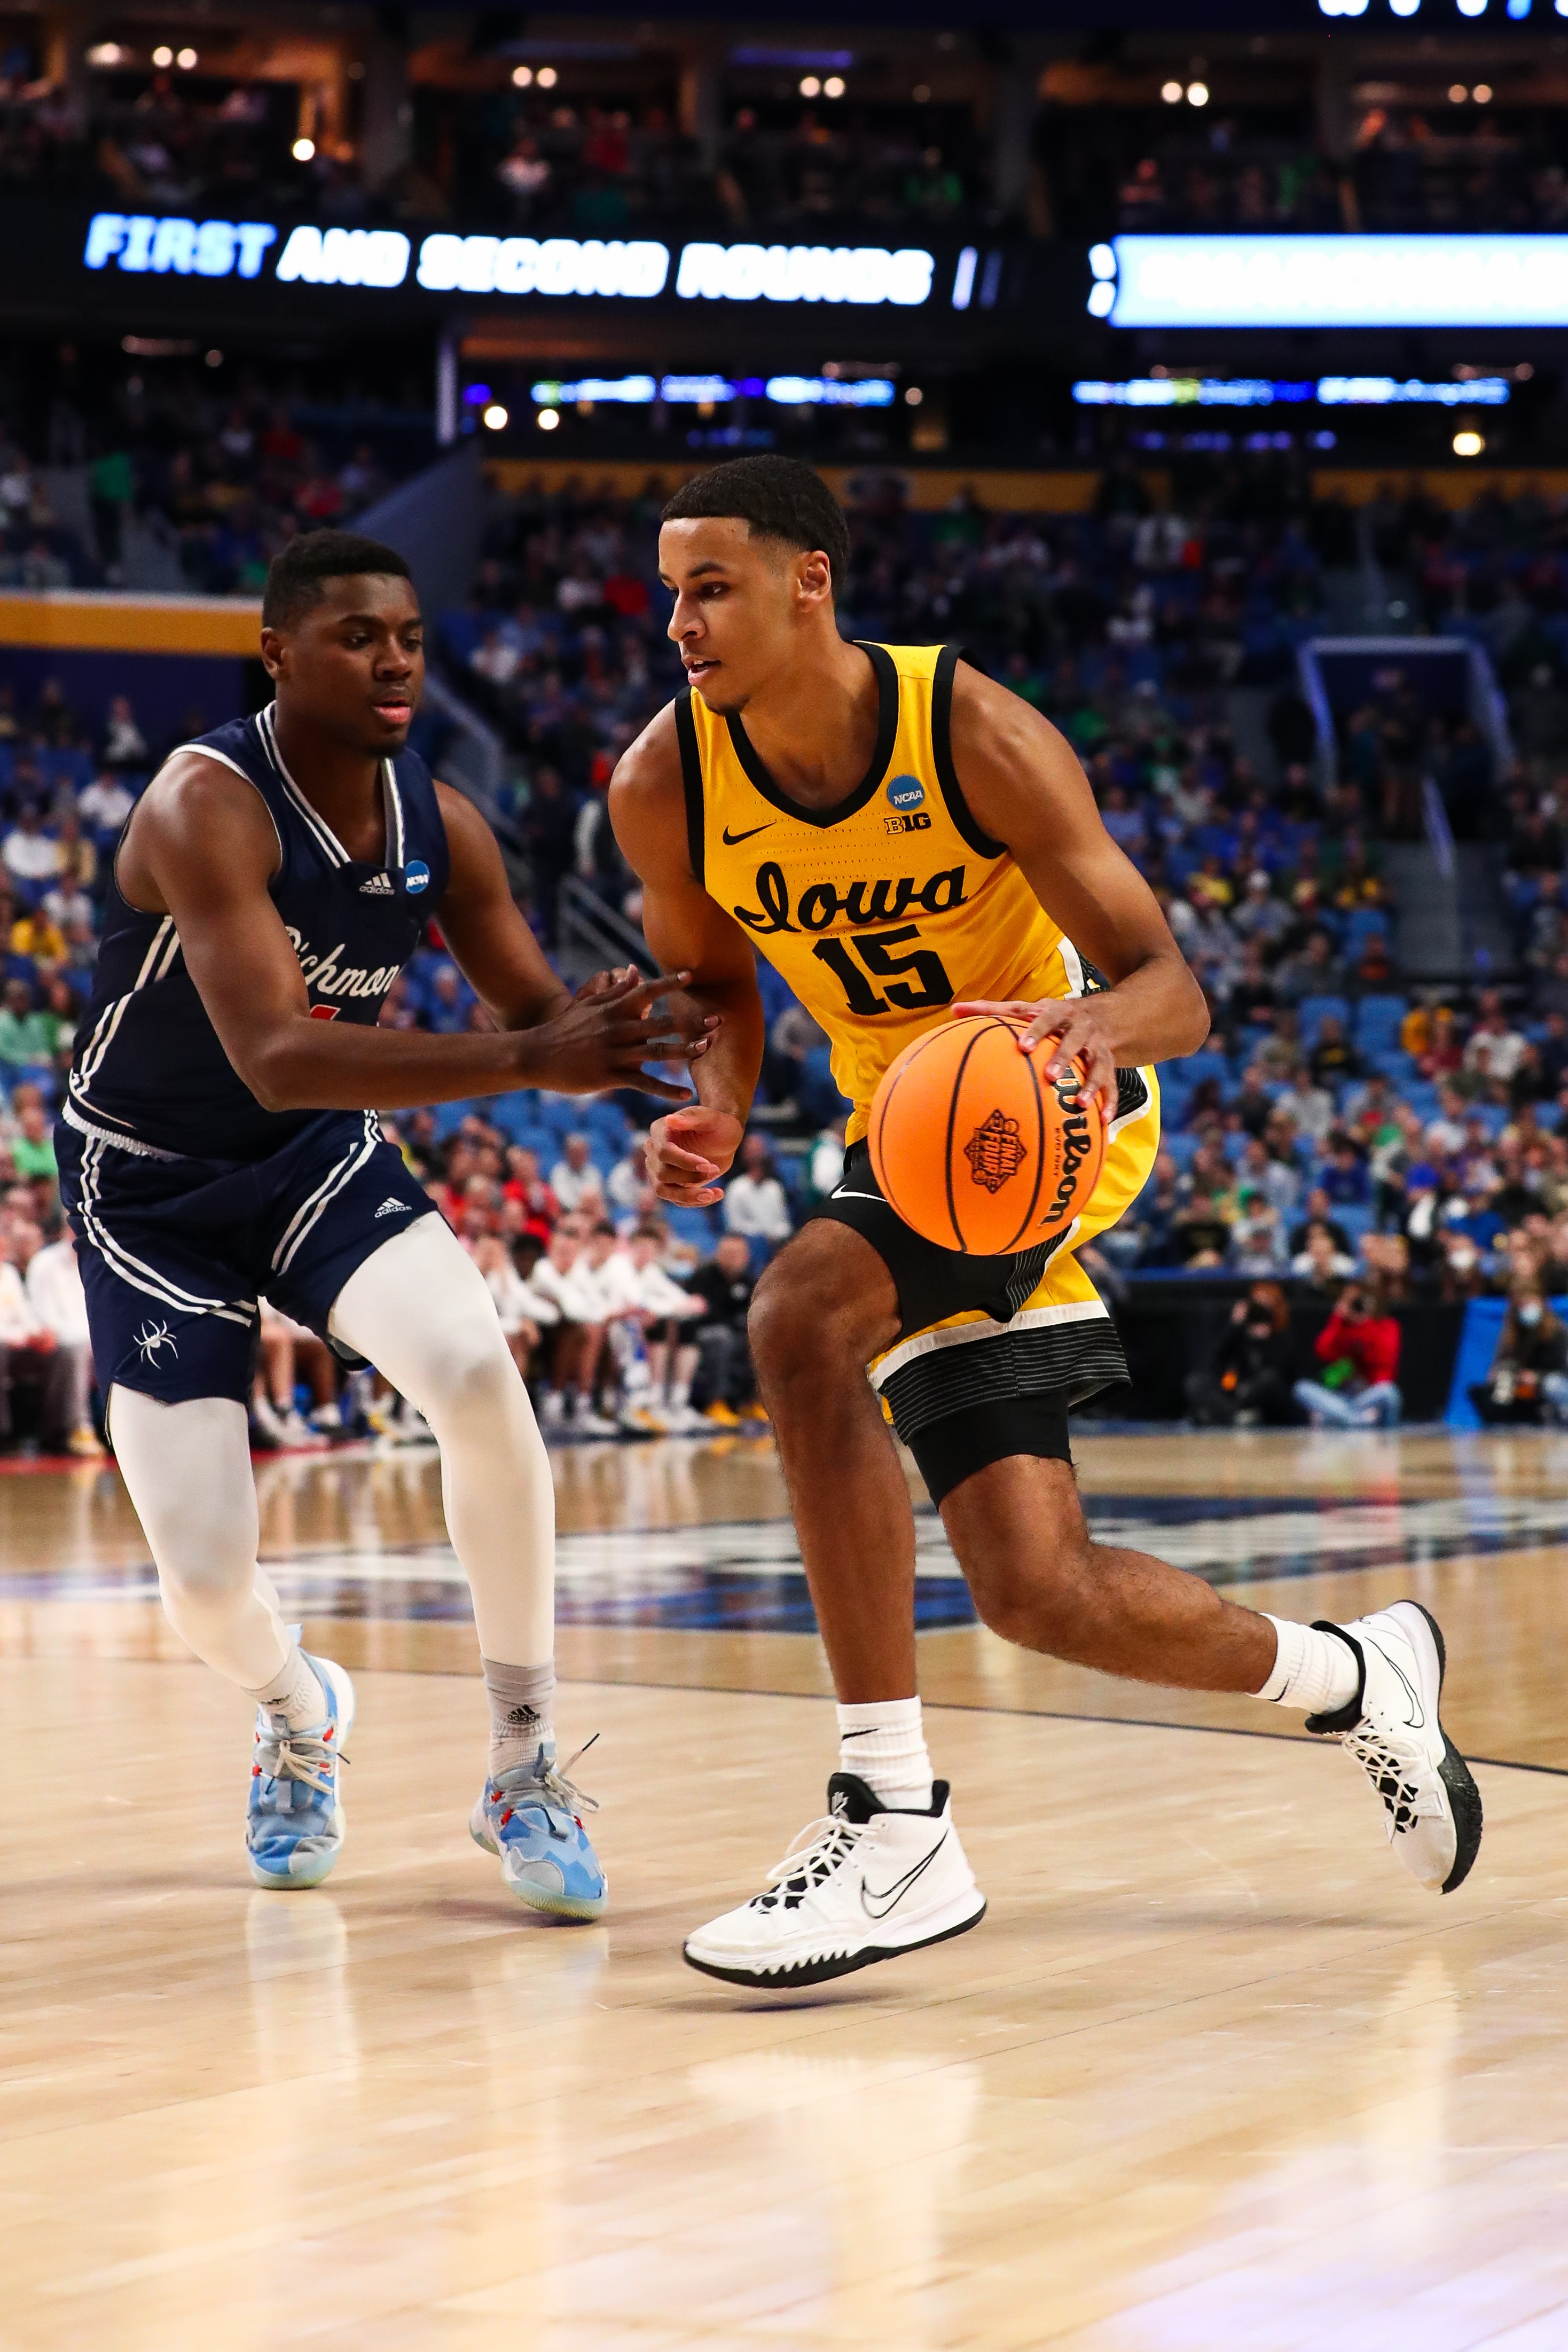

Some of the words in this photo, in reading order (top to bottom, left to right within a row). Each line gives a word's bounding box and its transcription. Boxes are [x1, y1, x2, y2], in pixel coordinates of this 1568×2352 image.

[85, 213, 277, 278] FIRST
[276, 226, 411, 288] AND
[417, 234, 670, 297] SECOND
[676, 242, 934, 306] ROUNDS
[893, 790, 923, 805] NCAA
[359, 885, 395, 895] adidas
[734, 861, 969, 934] Iowa
[285, 926, 399, 997] chmon
[812, 924, 954, 1016] 15
[980, 1130, 1000, 1174] FOUR
[1000, 1132, 1018, 1175] FINAL
[374, 1206, 413, 1218] adidas
